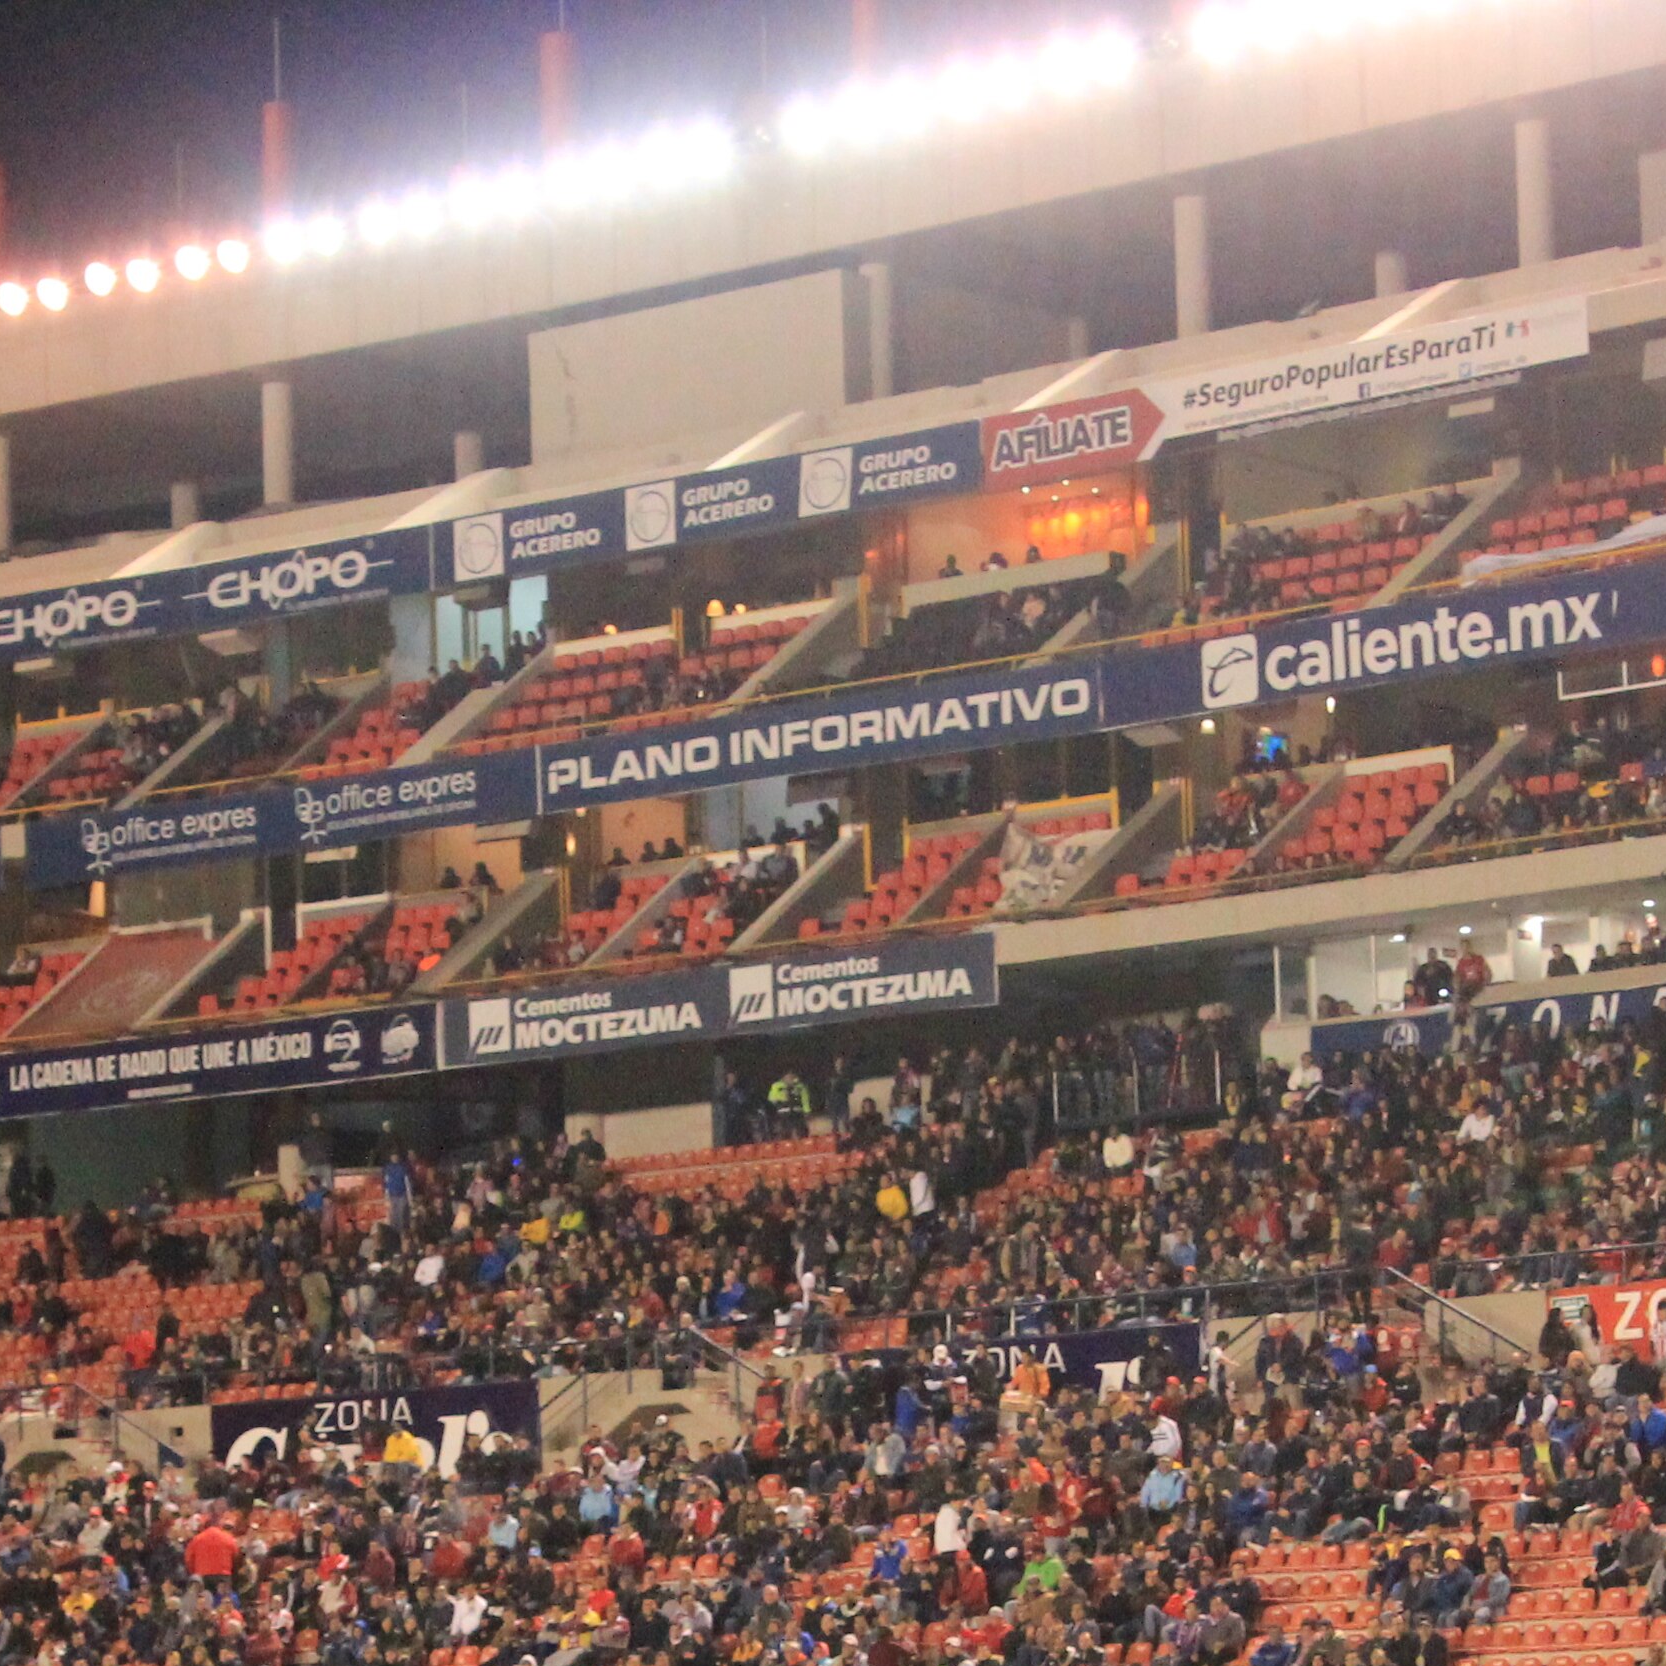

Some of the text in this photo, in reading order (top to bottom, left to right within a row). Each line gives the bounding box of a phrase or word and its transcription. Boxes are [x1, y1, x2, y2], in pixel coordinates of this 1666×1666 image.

[1183, 321, 1496, 410] #SeguroPopularEsParaTi
[859, 445, 930, 474] GRUPO
[990, 405, 1132, 471] AFÍLIATE
[682, 477, 751, 507] GRUPO
[859, 462, 958, 495] ACERERO
[509, 511, 577, 539] GRUPO
[683, 494, 775, 528] ACERERO
[511, 528, 601, 560] ACERERO
[208, 550, 368, 610] CHOPO
[1264, 592, 1602, 693] caliente.mx
[547, 677, 1091, 795] PLANO INFORMATIVO
[326, 767, 477, 815] office expres
[112, 805, 257, 847] office expres
[777, 957, 879, 984] Cementos
[513, 990, 611, 1018] Cementos
[778, 968, 972, 1019] MOCTEZUMA
[514, 1002, 702, 1052] MOCTEZUMA
[9, 1031, 313, 1092] LA CADENA DE RADIO QUE UNE A MÉXICO
